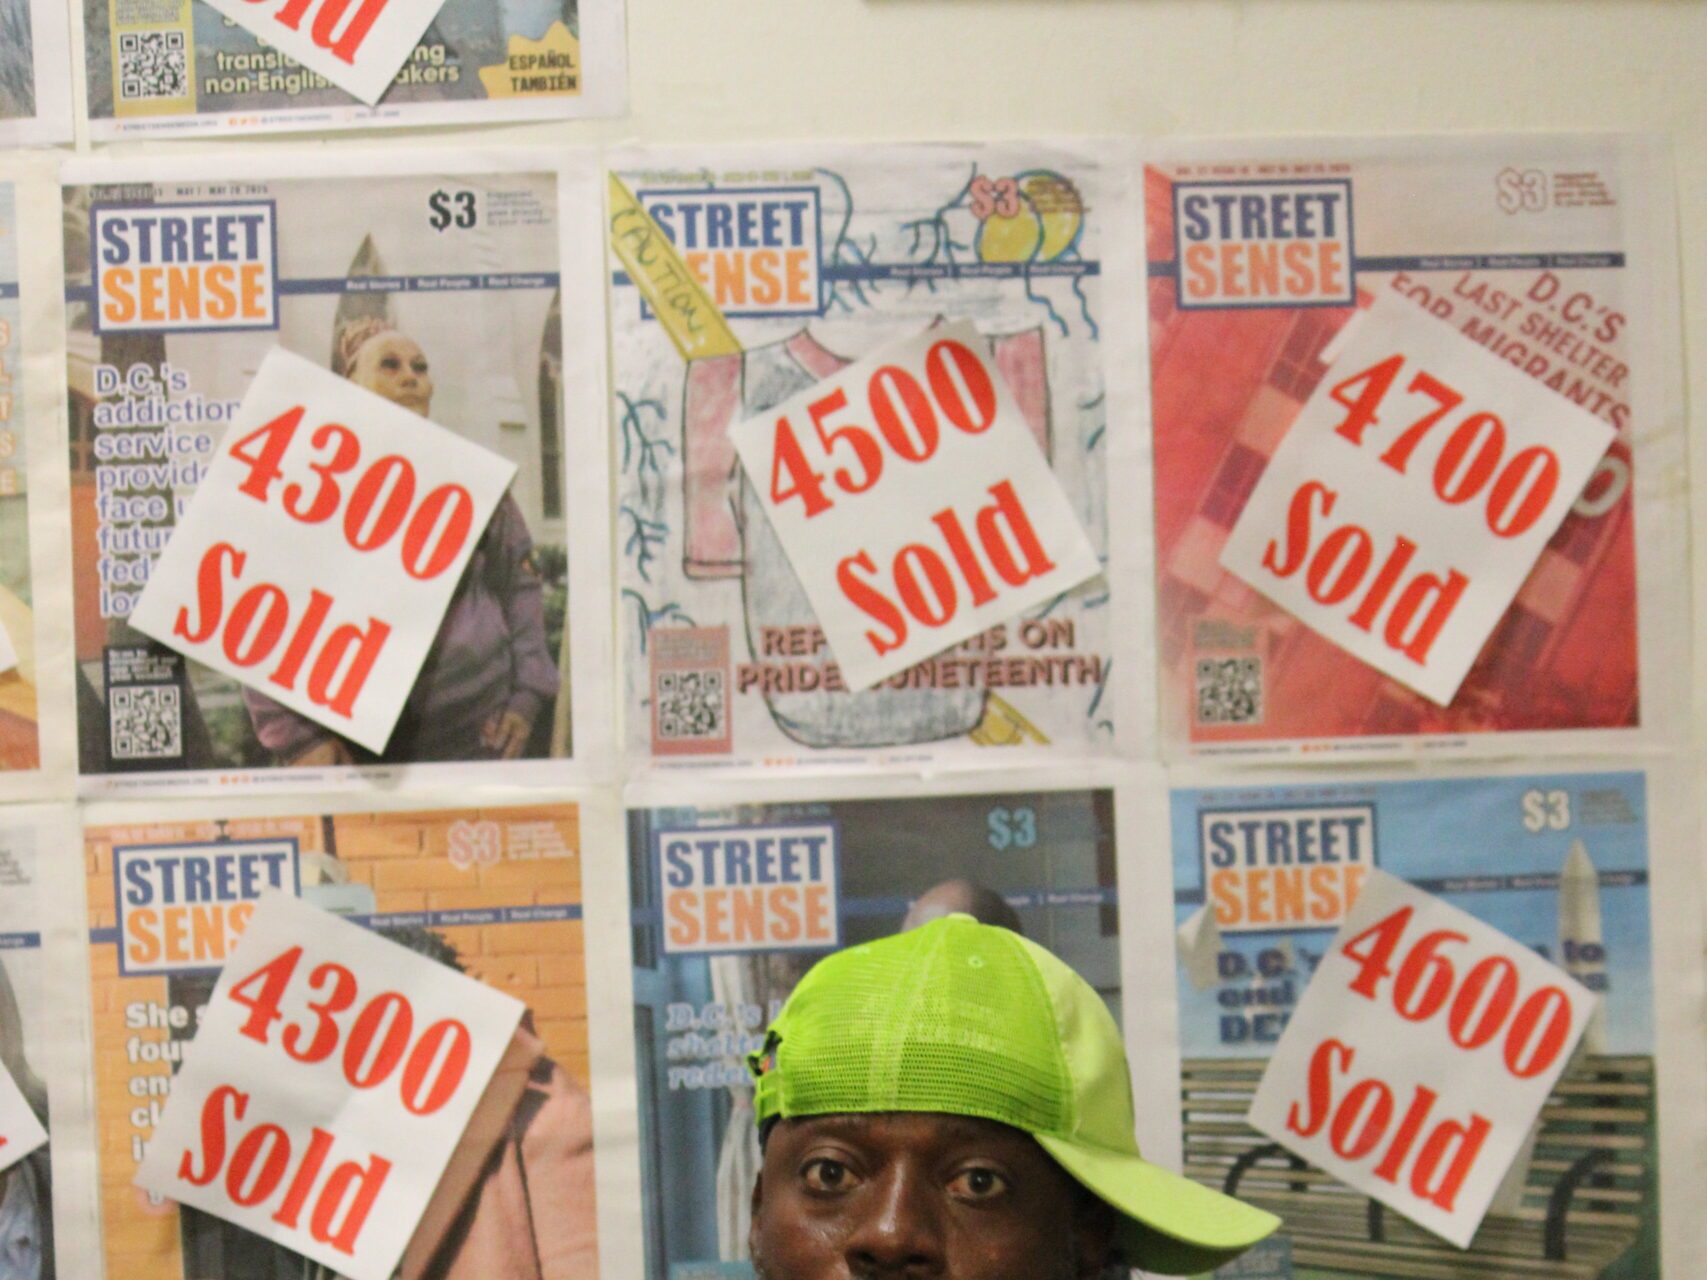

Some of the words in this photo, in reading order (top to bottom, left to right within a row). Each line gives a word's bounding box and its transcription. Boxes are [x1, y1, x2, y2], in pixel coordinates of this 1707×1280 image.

[508, 49, 576, 71] ESPAÑOL
[511, 73, 578, 93] TAMBIÉN
[428, 189, 477, 232] $3
[970, 174, 1019, 221] $3
[1183, 192, 1340, 241] STREET
[1497, 167, 1548, 215] $3
[101, 213, 265, 265] STREET
[649, 200, 810, 248] STREET
[102, 264, 267, 323] SENSE
[686, 249, 812, 306] ENSE
[1185, 241, 1344, 300] SENSE
[1453, 271, 1522, 321] LAST
[1519, 311, 1630, 388] SHELTER
[1527, 271, 1627, 344] D.C.'S
[95, 364, 188, 394] D.C.'s
[96, 428, 211, 456] service
[770, 340, 996, 518] 4500
[1330, 355, 1560, 540] 4700
[99, 495, 166, 520] face
[230, 405, 473, 581] 4300
[836, 480, 1055, 656] Sold
[1262, 480, 1468, 666] Sold
[174, 542, 391, 719] Sold
[1019, 618, 1075, 649] ON
[987, 807, 1037, 850] $3
[1522, 788, 1570, 833] $3
[448, 819, 501, 870] $3
[666, 836, 827, 888] STREET
[1208, 816, 1366, 867] STREET
[125, 852, 288, 906] STREET
[667, 886, 830, 946] SENSE
[125, 1001, 189, 1029] She
[1343, 905, 1572, 1080] 4600
[230, 945, 472, 1115] 4300
[1286, 1037, 1492, 1213] Sold
[178, 1085, 392, 1256] Sold
